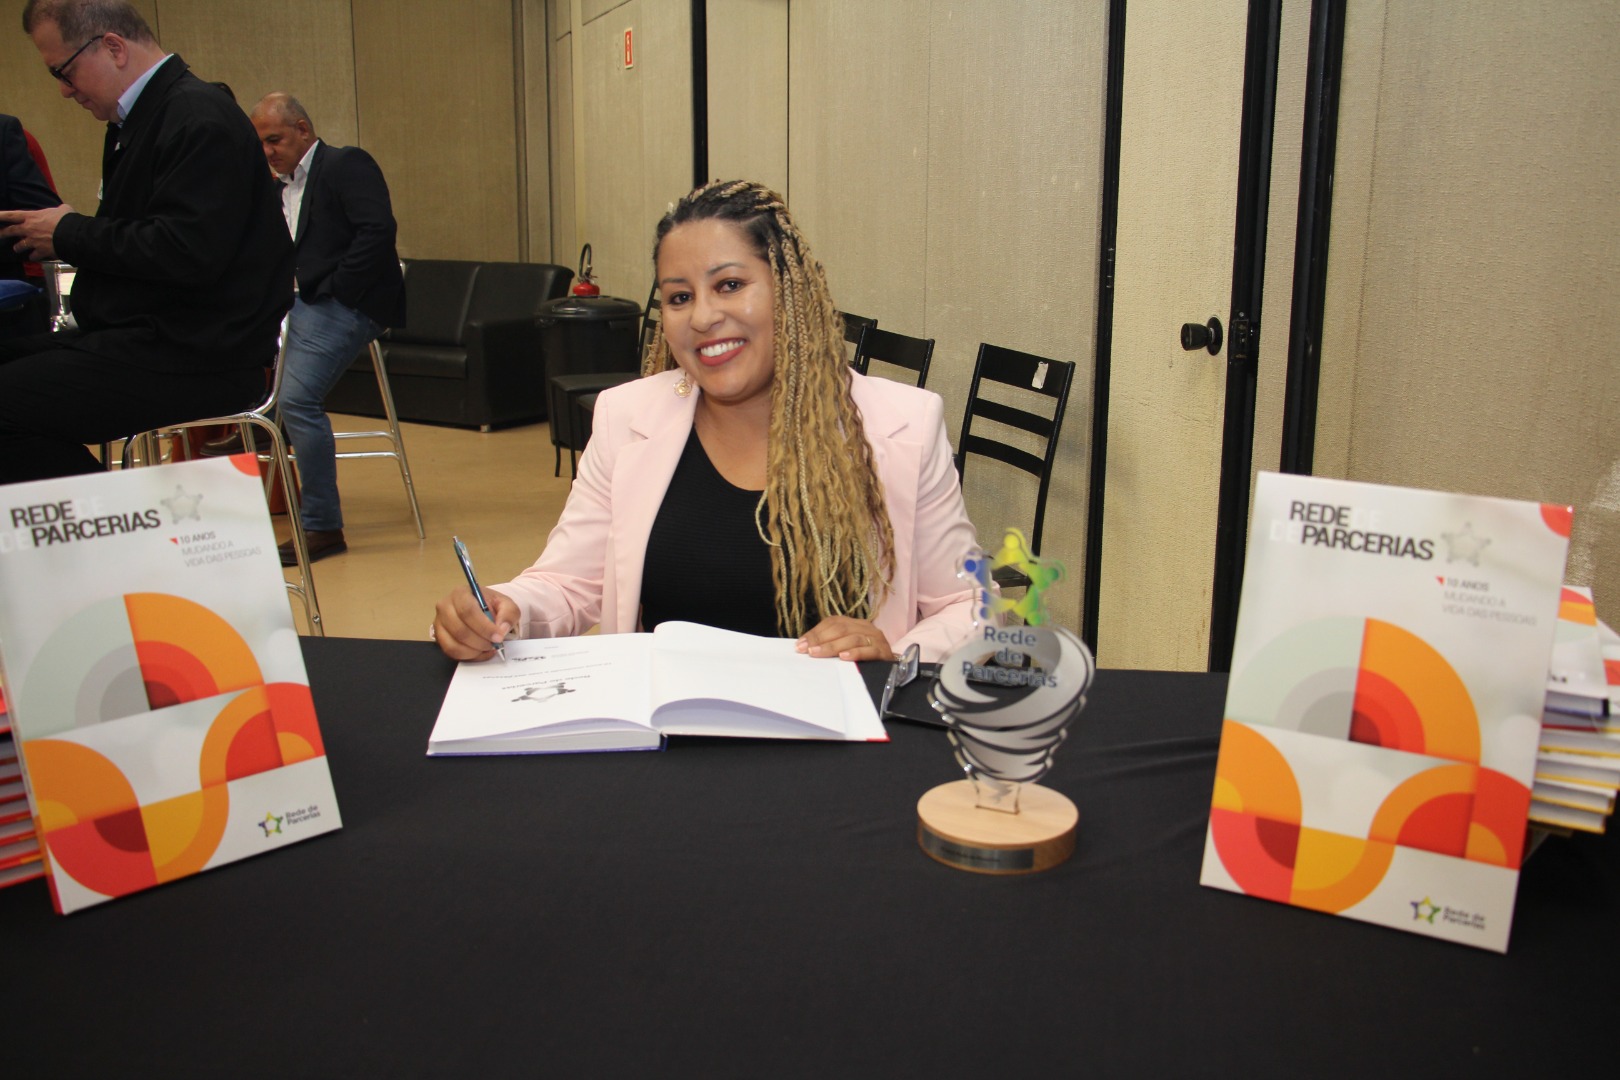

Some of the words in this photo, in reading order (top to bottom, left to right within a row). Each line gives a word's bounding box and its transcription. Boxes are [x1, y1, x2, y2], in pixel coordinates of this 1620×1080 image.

[10, 500, 75, 528] REDE
[1289, 500, 1351, 527] REDE
[31, 509, 161, 548] PARCERIAS
[180, 535, 191, 545] 10
[192, 531, 216, 543] ANOS
[1301, 524, 1435, 561] PARCERIAS
[182, 542, 226, 556] MUDANDO
[227, 540, 234, 548] A
[1446, 577, 1459, 588] 10
[1461, 579, 1490, 592] ANOS
[983, 626, 1037, 647] Rede
[994, 648, 1023, 664] de
[961, 660, 1058, 689] Parcerias
[286, 808, 306, 818] Rede
[287, 812, 321, 825] Parcerias
